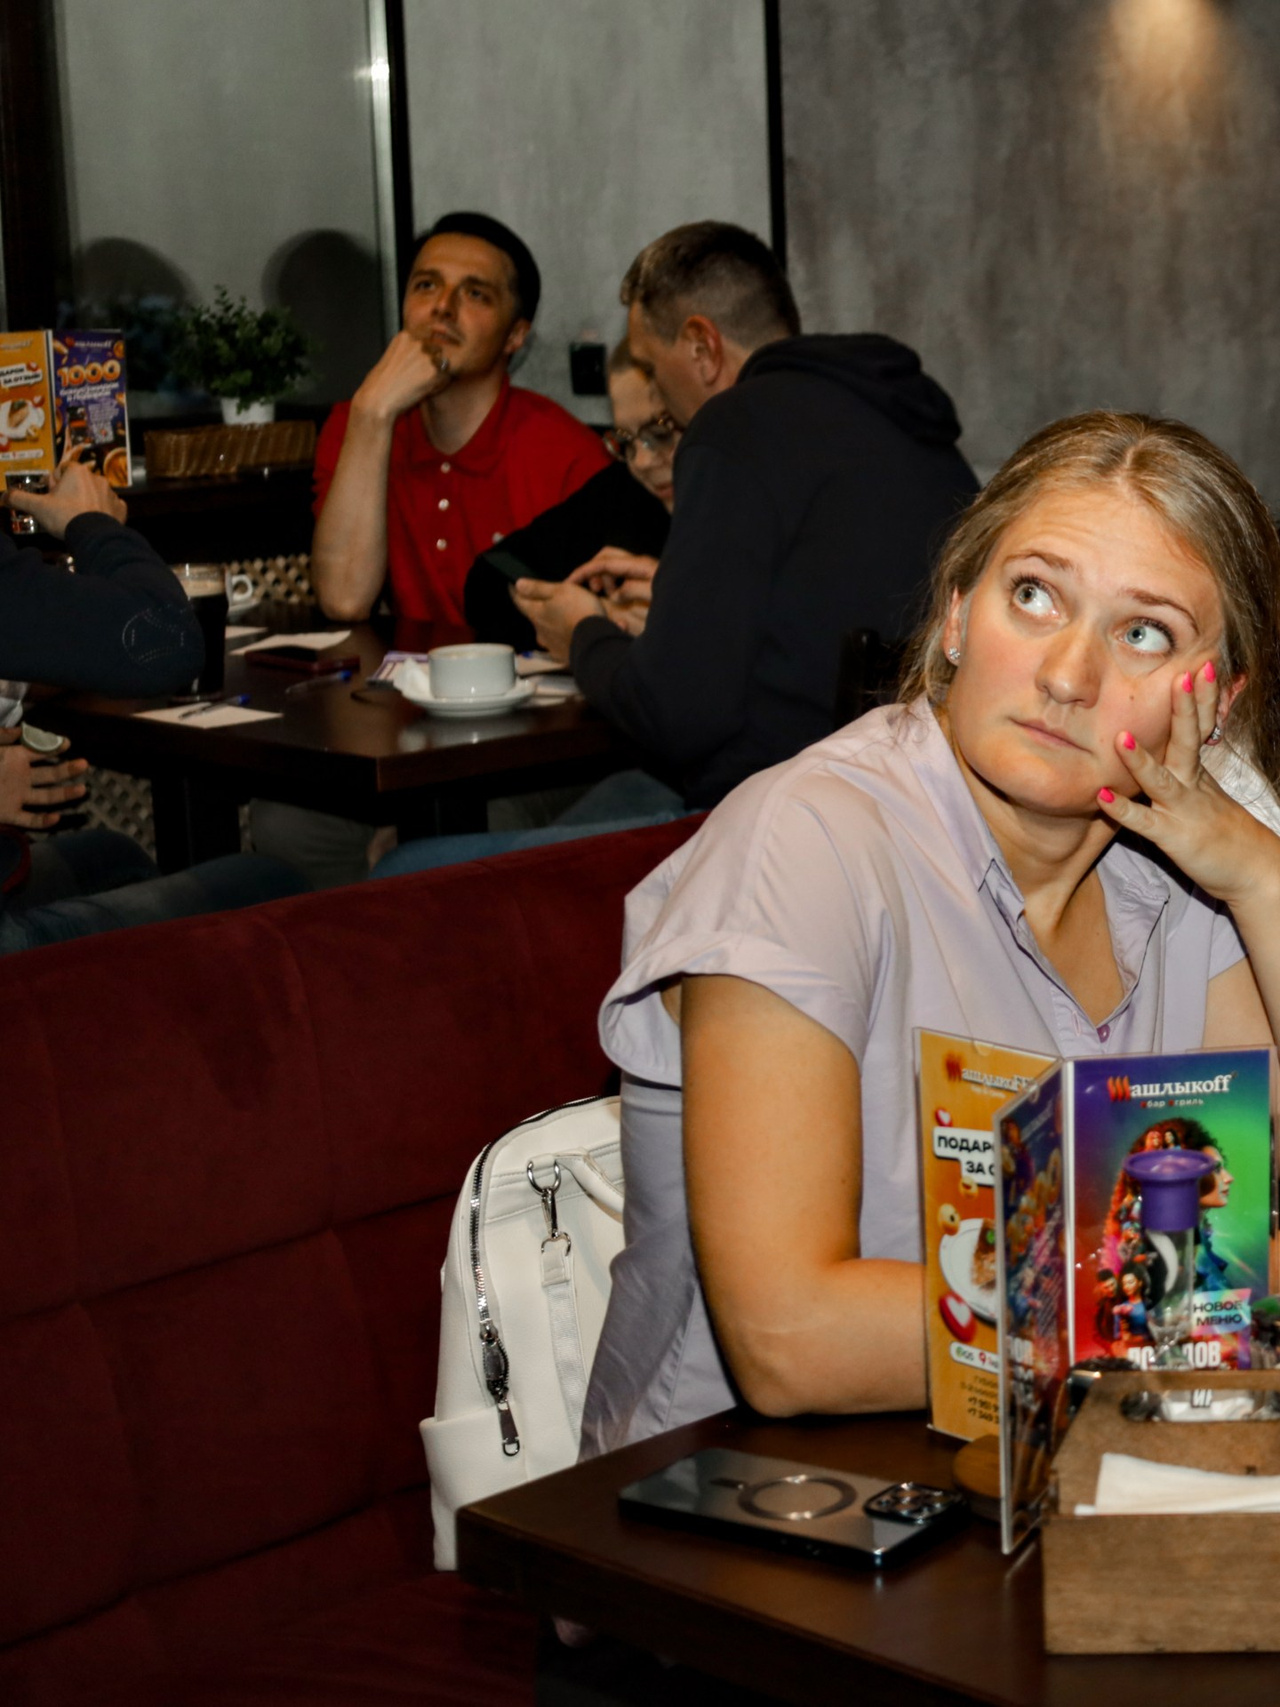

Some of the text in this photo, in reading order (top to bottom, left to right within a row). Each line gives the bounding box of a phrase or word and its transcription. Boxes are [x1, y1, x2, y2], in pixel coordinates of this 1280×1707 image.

[57, 360, 121, 388] 1000
[937, 1135, 994, 1153] ПОДАР
[966, 1161, 985, 1175] ЗА
[1194, 1301, 1242, 1312] НОВОЕ
[1196, 1314, 1242, 1326] МЕНЮ
